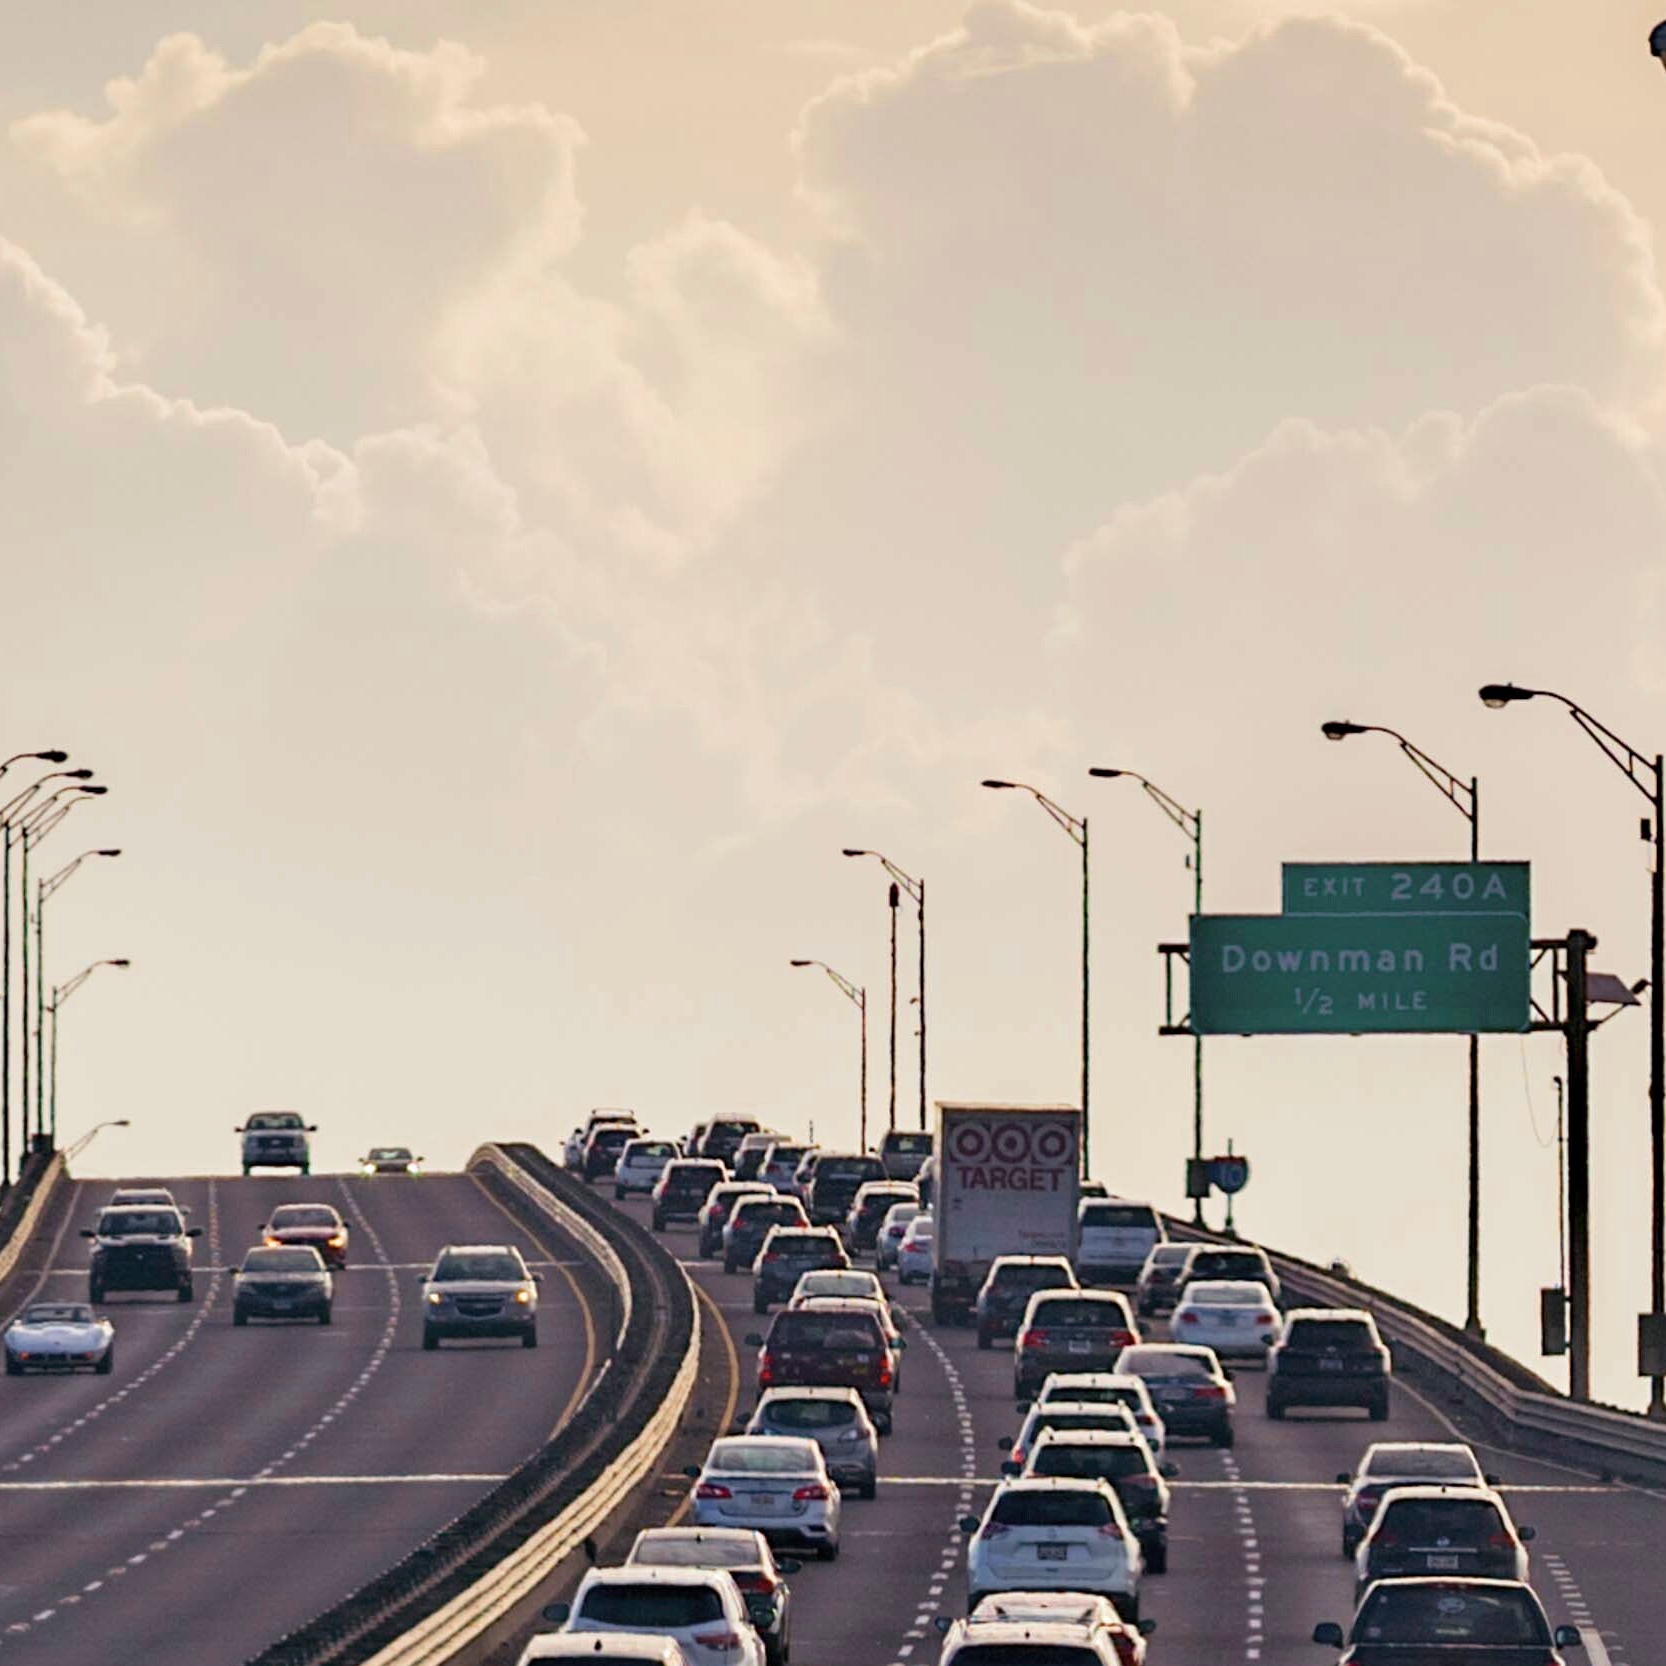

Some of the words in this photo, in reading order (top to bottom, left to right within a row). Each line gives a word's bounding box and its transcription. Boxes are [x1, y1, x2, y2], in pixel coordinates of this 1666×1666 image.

[1303, 877, 1365, 897] EXIT
[1390, 872, 1507, 900] 240A
[1222, 944, 1424, 973] Downman
[1449, 943, 1498, 972] Rd
[1358, 991, 1428, 1011] MILE
[957, 1165, 1065, 1192] TARGET
